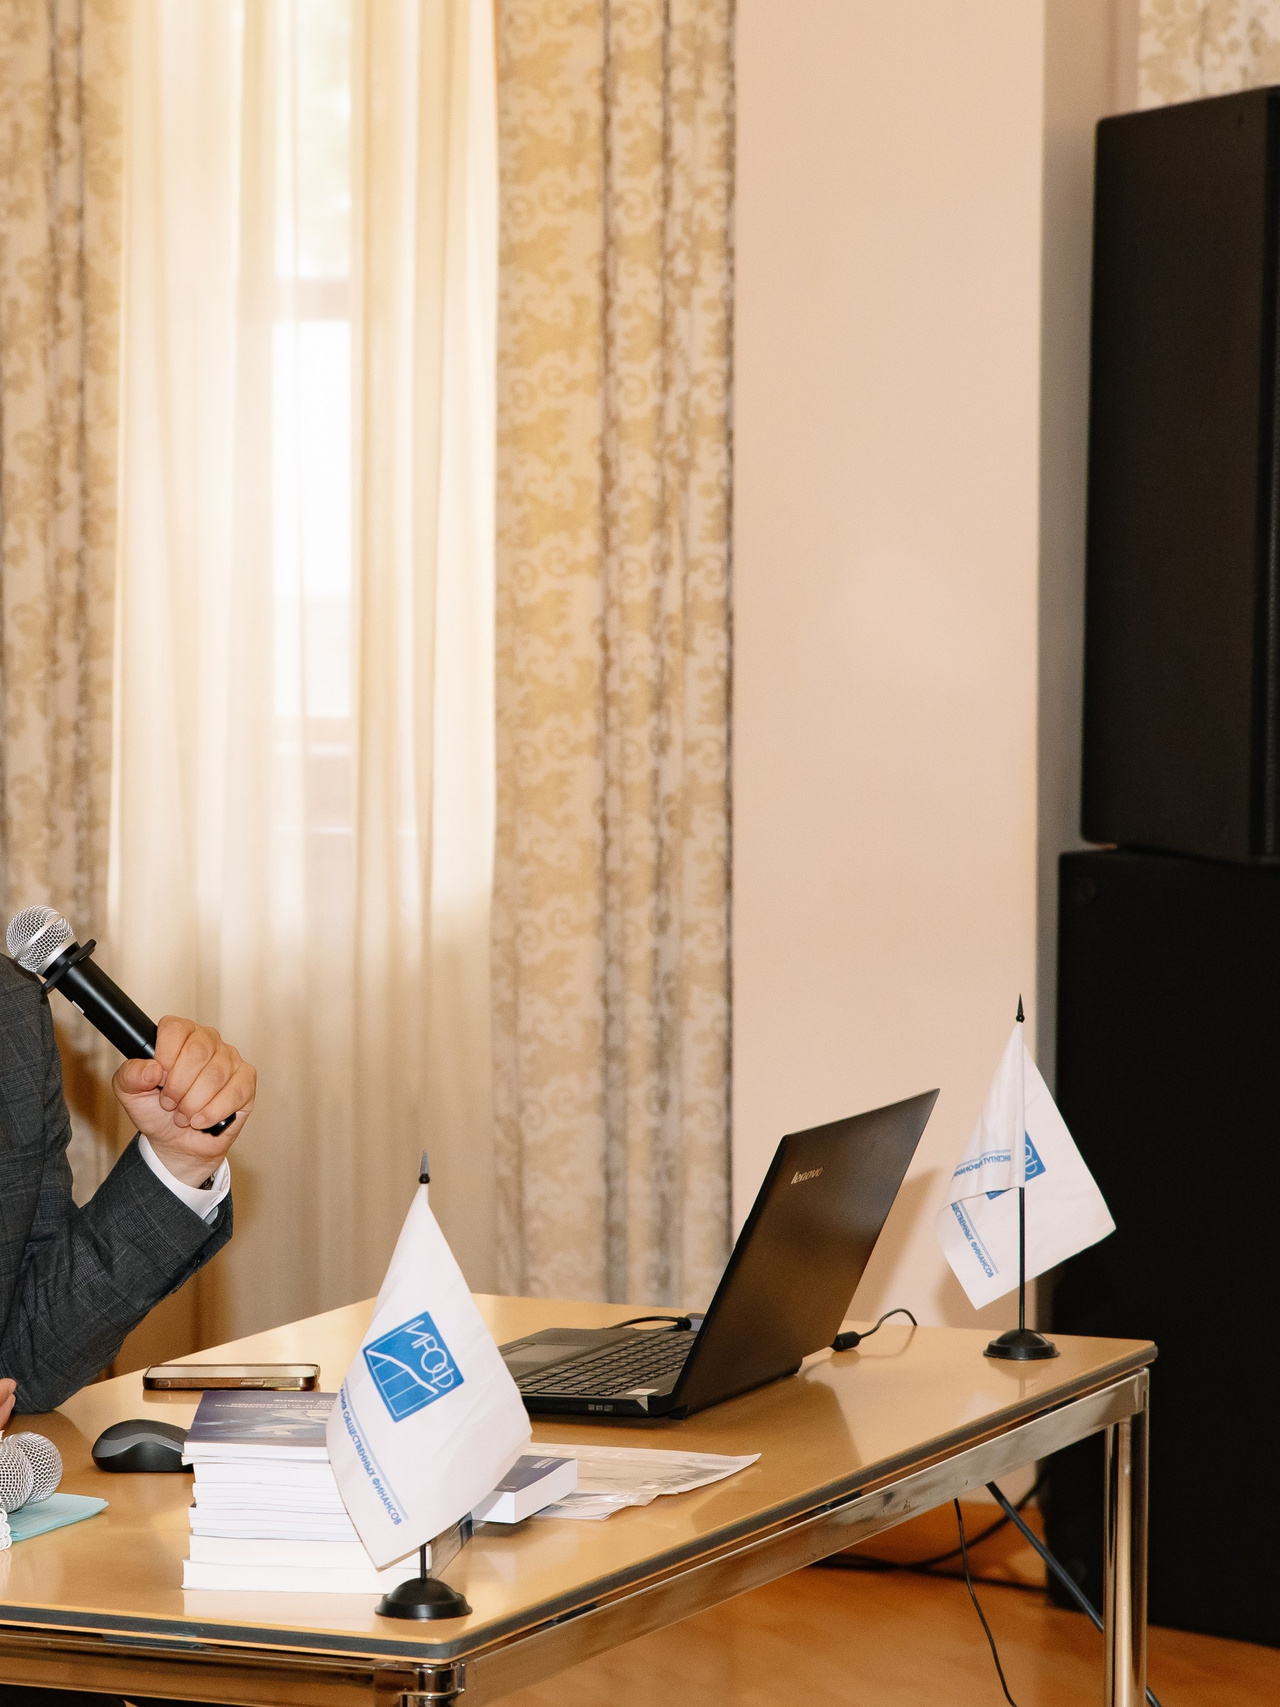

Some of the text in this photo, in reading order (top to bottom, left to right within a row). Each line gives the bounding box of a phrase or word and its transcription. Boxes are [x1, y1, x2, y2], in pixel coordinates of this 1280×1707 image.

[970, 1241, 994, 1278] ФИНАНСОВ
[404, 1320, 455, 1389] ИРОФ
[342, 1410, 376, 1478] ОБЩЕСТВЕННЫХ
[372, 1477, 402, 1526] ФИНАНСОВ
